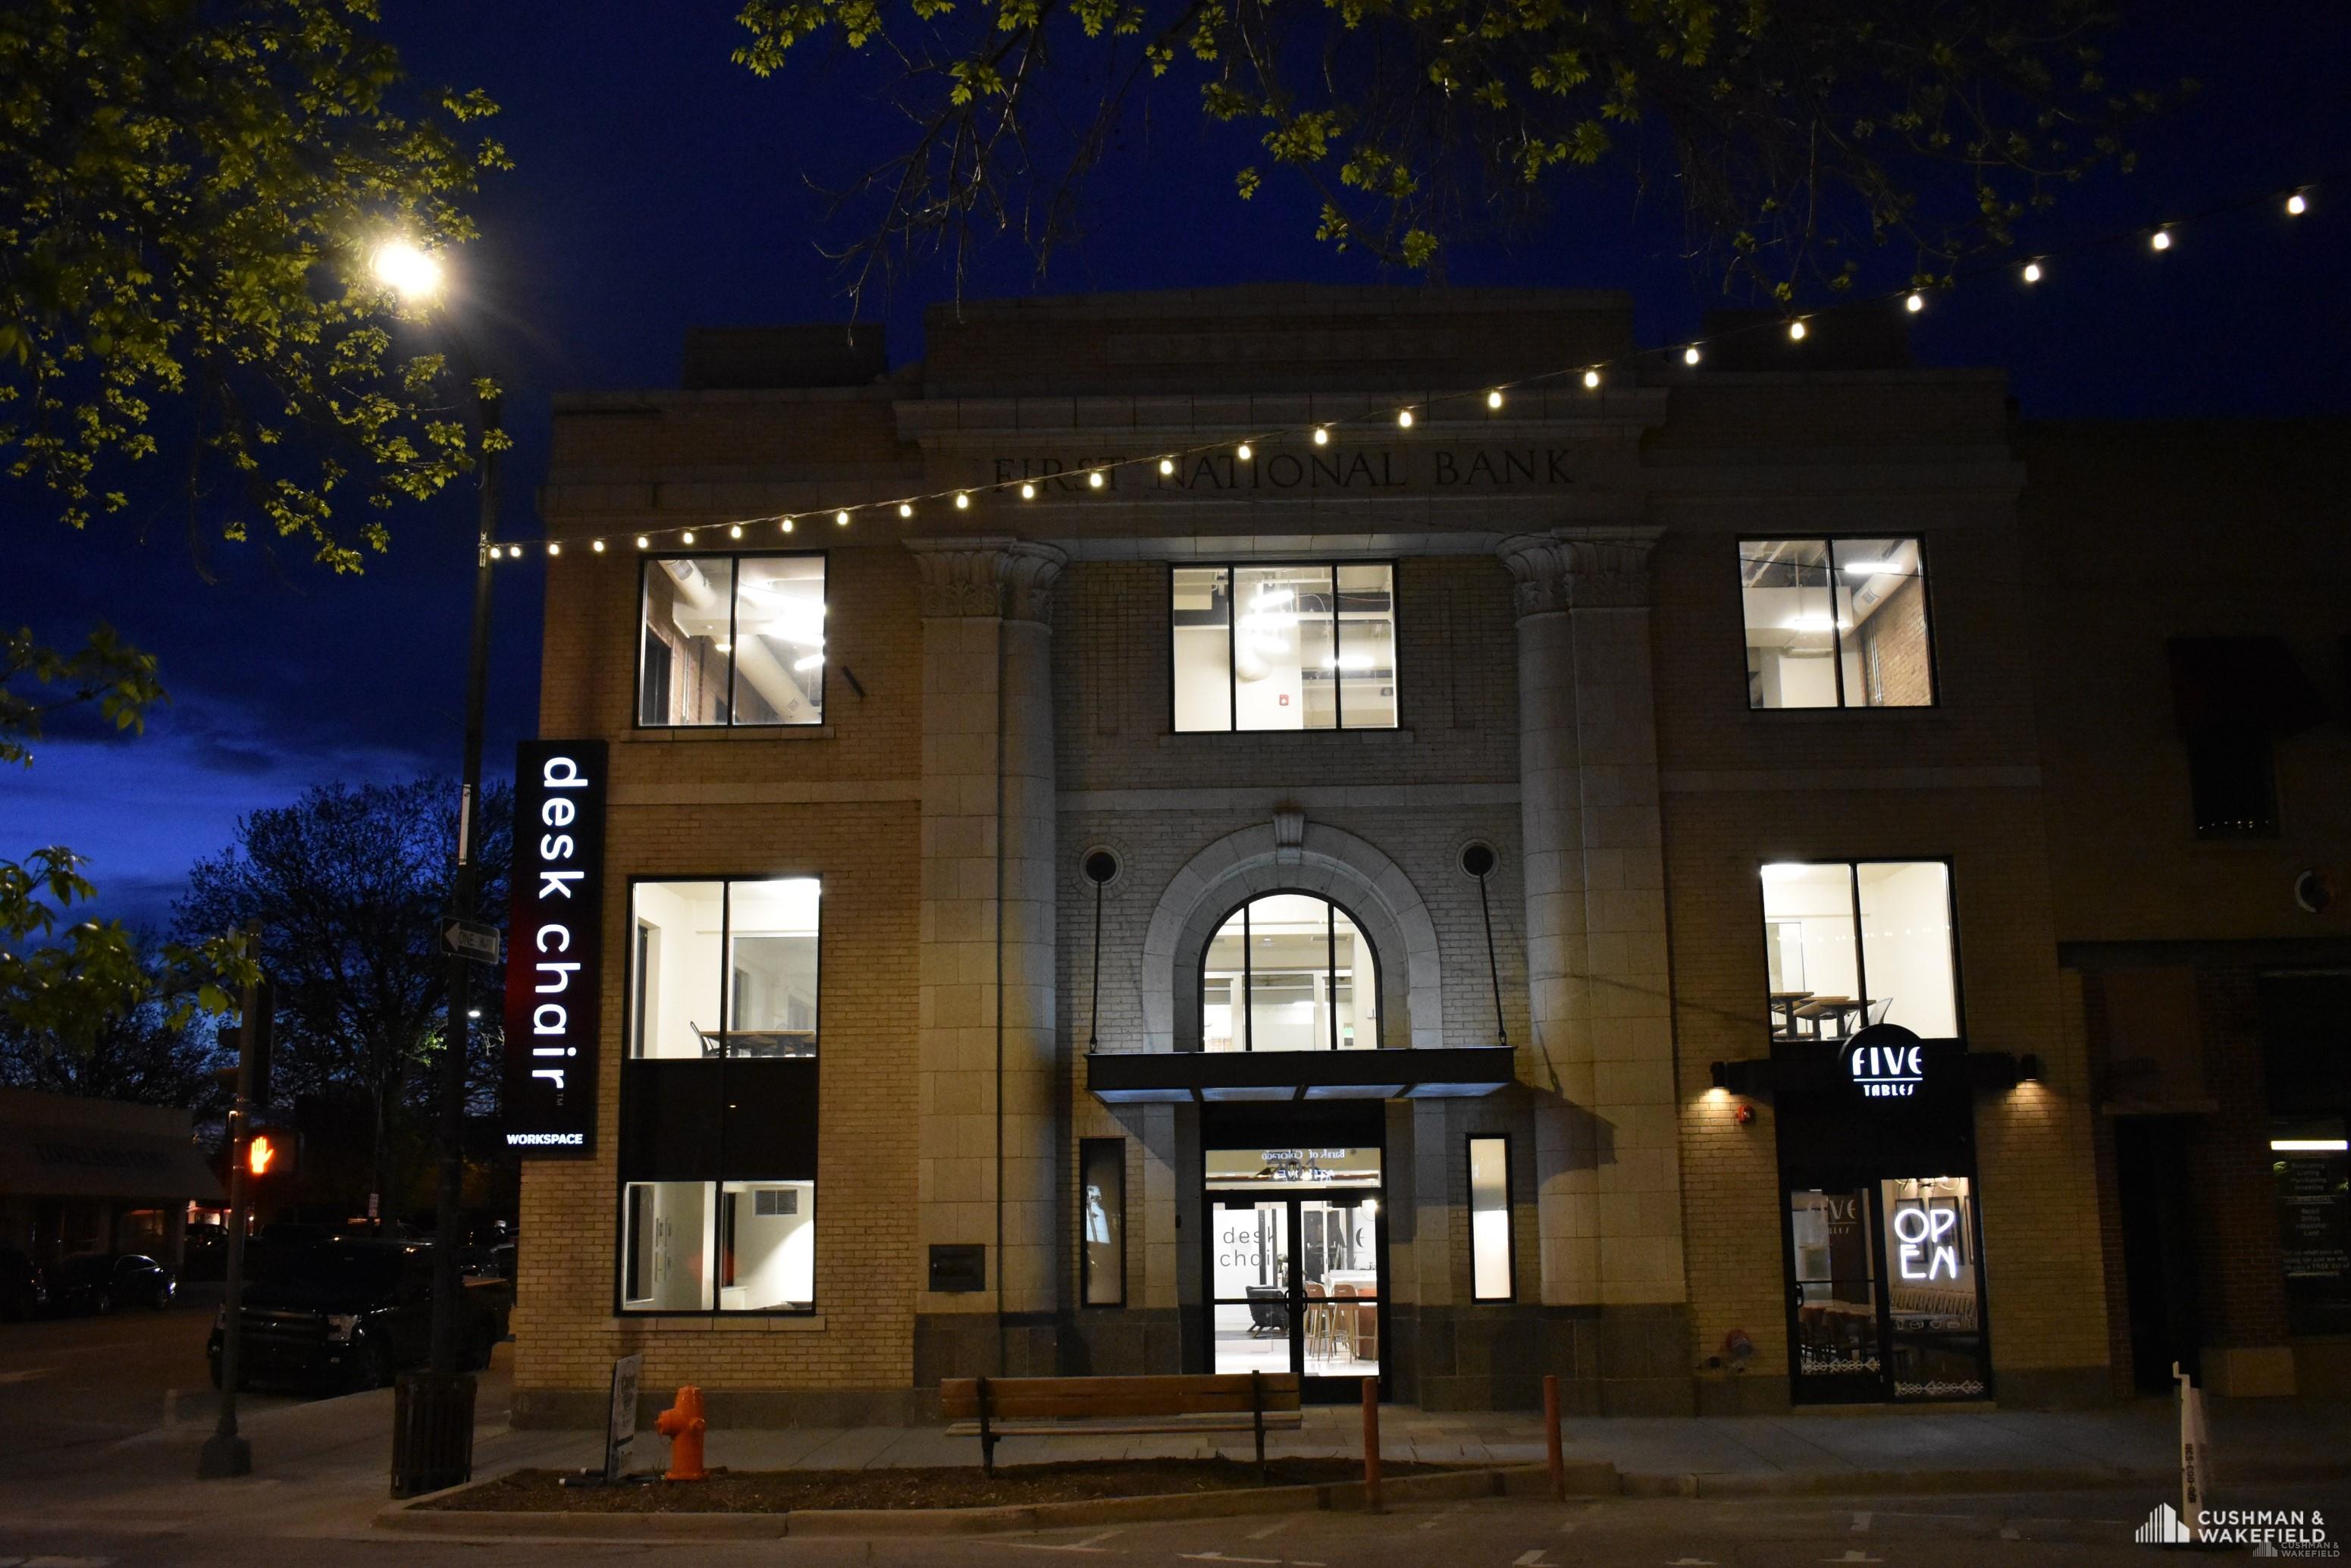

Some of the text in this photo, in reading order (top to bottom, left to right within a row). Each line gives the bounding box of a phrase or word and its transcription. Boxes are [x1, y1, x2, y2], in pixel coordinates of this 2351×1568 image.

[995, 450, 1575, 493] FIRST NATIONAL BANK
[538, 757, 588, 899] desk
[460, 933, 474, 946] ONE
[531, 923, 581, 1089] chair
[1852, 1046, 1923, 1075] FIVE
[1864, 1083, 1914, 1097] TABLES
[506, 1134, 584, 1145] WORKSPACE
